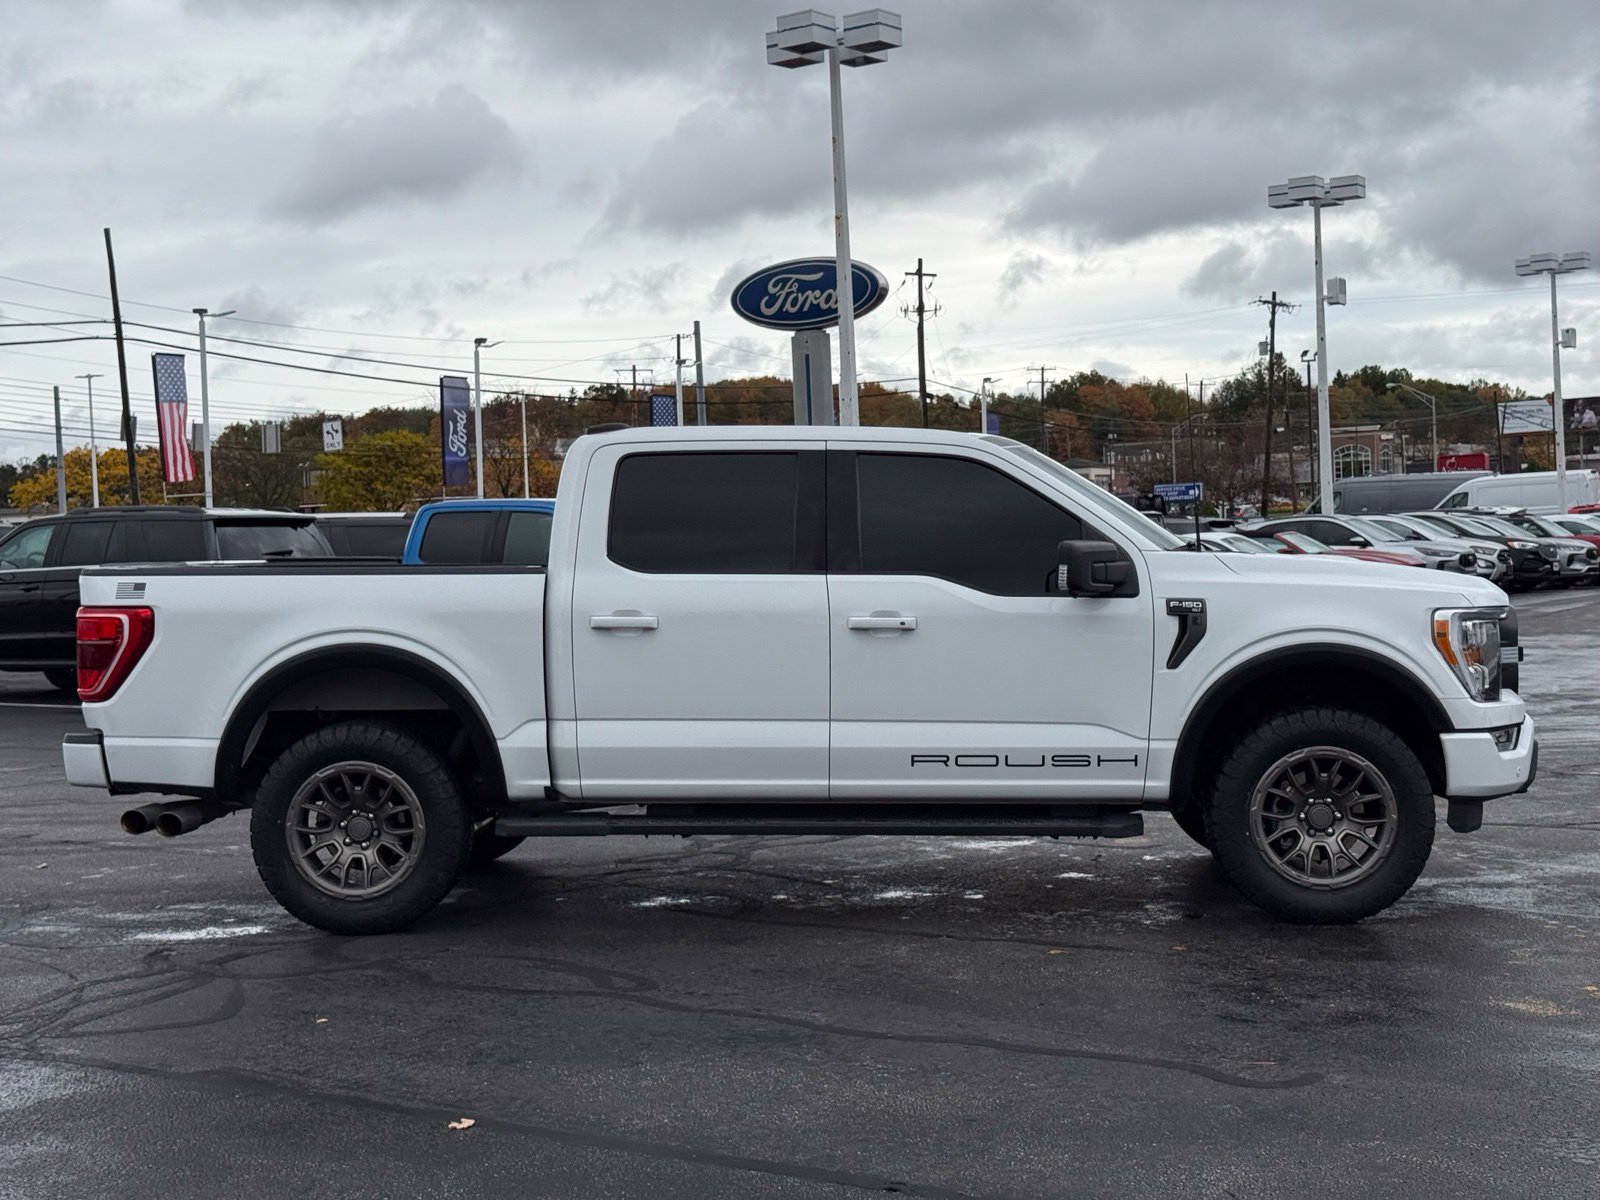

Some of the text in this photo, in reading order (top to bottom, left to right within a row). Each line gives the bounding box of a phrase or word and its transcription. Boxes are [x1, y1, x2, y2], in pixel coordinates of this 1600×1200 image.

[449, 408, 467, 457] Ford
[326, 441, 341, 449] ONLY
[911, 755, 1138, 767] ROUSH
